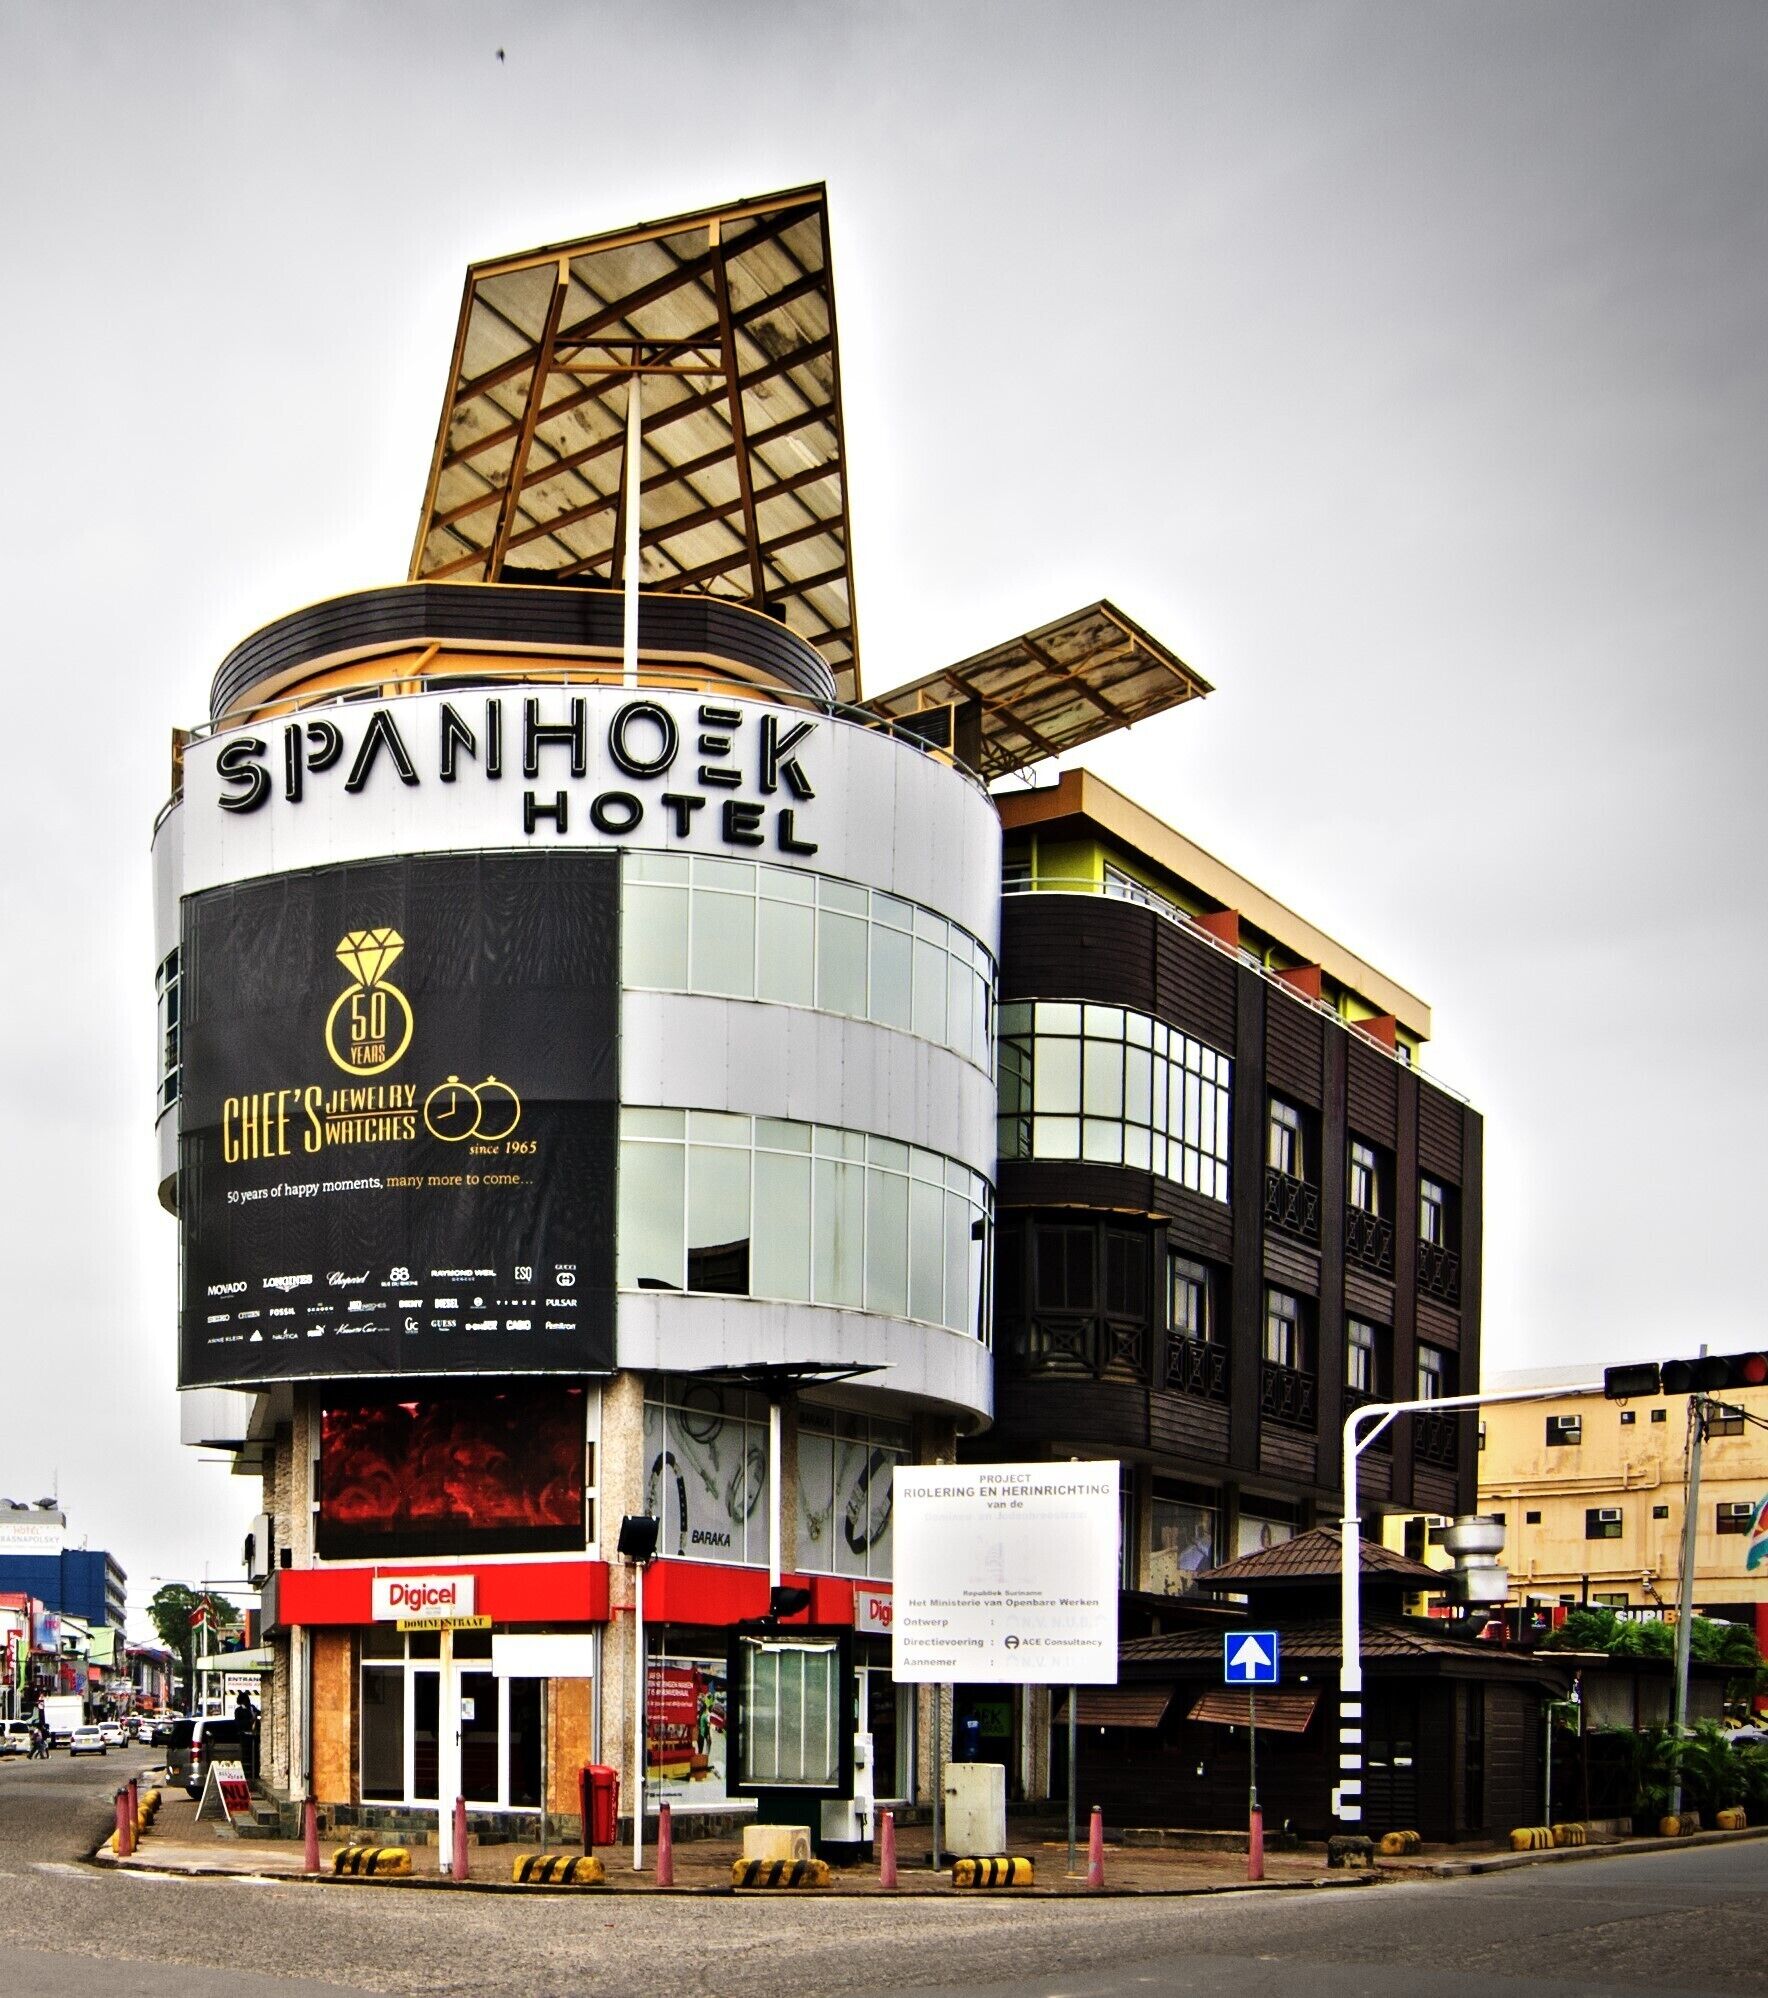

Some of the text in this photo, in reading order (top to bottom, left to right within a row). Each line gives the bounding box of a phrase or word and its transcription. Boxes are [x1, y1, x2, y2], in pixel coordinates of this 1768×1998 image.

[217, 695, 818, 811] SPANHOEK
[522, 790, 818, 856] HOTEL
[351, 992, 386, 1041] 50
[350, 1044, 385, 1065] YEARS
[326, 1084, 417, 1113] JEWELRY
[224, 1086, 322, 1163] CHEE'S
[325, 1116, 415, 1145] WATCHES
[469, 1141, 537, 1155] since 1965
[227, 1191, 240, 1203] 50
[240, 1189, 268, 1205] years
[271, 1185, 283, 1198] of
[284, 1184, 319, 1198] happy
[322, 1177, 383, 1193] moments,
[386, 1176, 423, 1189] many
[428, 1175, 462, 1186] more
[466, 1174, 479, 1185] to
[207, 1281, 247, 1296] MOVADO
[390, 1267, 410, 1281] 88
[515, 1266, 532, 1281] ESQ
[546, 1299, 577, 1307] PULSAR
[431, 1319, 456, 1327] GUESS
[979, 1474, 1031, 1483] PROJECT
[904, 1484, 1110, 1498] RIOLERING EN HERINRICHTING
[987, 1500, 1023, 1509] van de
[692, 1530, 730, 1547] BARAKA
[390, 1582, 893, 1627] Digicel Digi
[909, 1599, 927, 1607] Het
[930, 1599, 980, 1607] Ministerie
[1006, 1599, 1056, 1608] Openbare
[1059, 1598, 1099, 1607] Werken
[903, 1618, 949, 1628] Ontwerp
[903, 1638, 984, 1648] Directievoering
[1045, 1637, 1102, 1647] Consultancy
[903, 1658, 956, 1666] Aannemer
